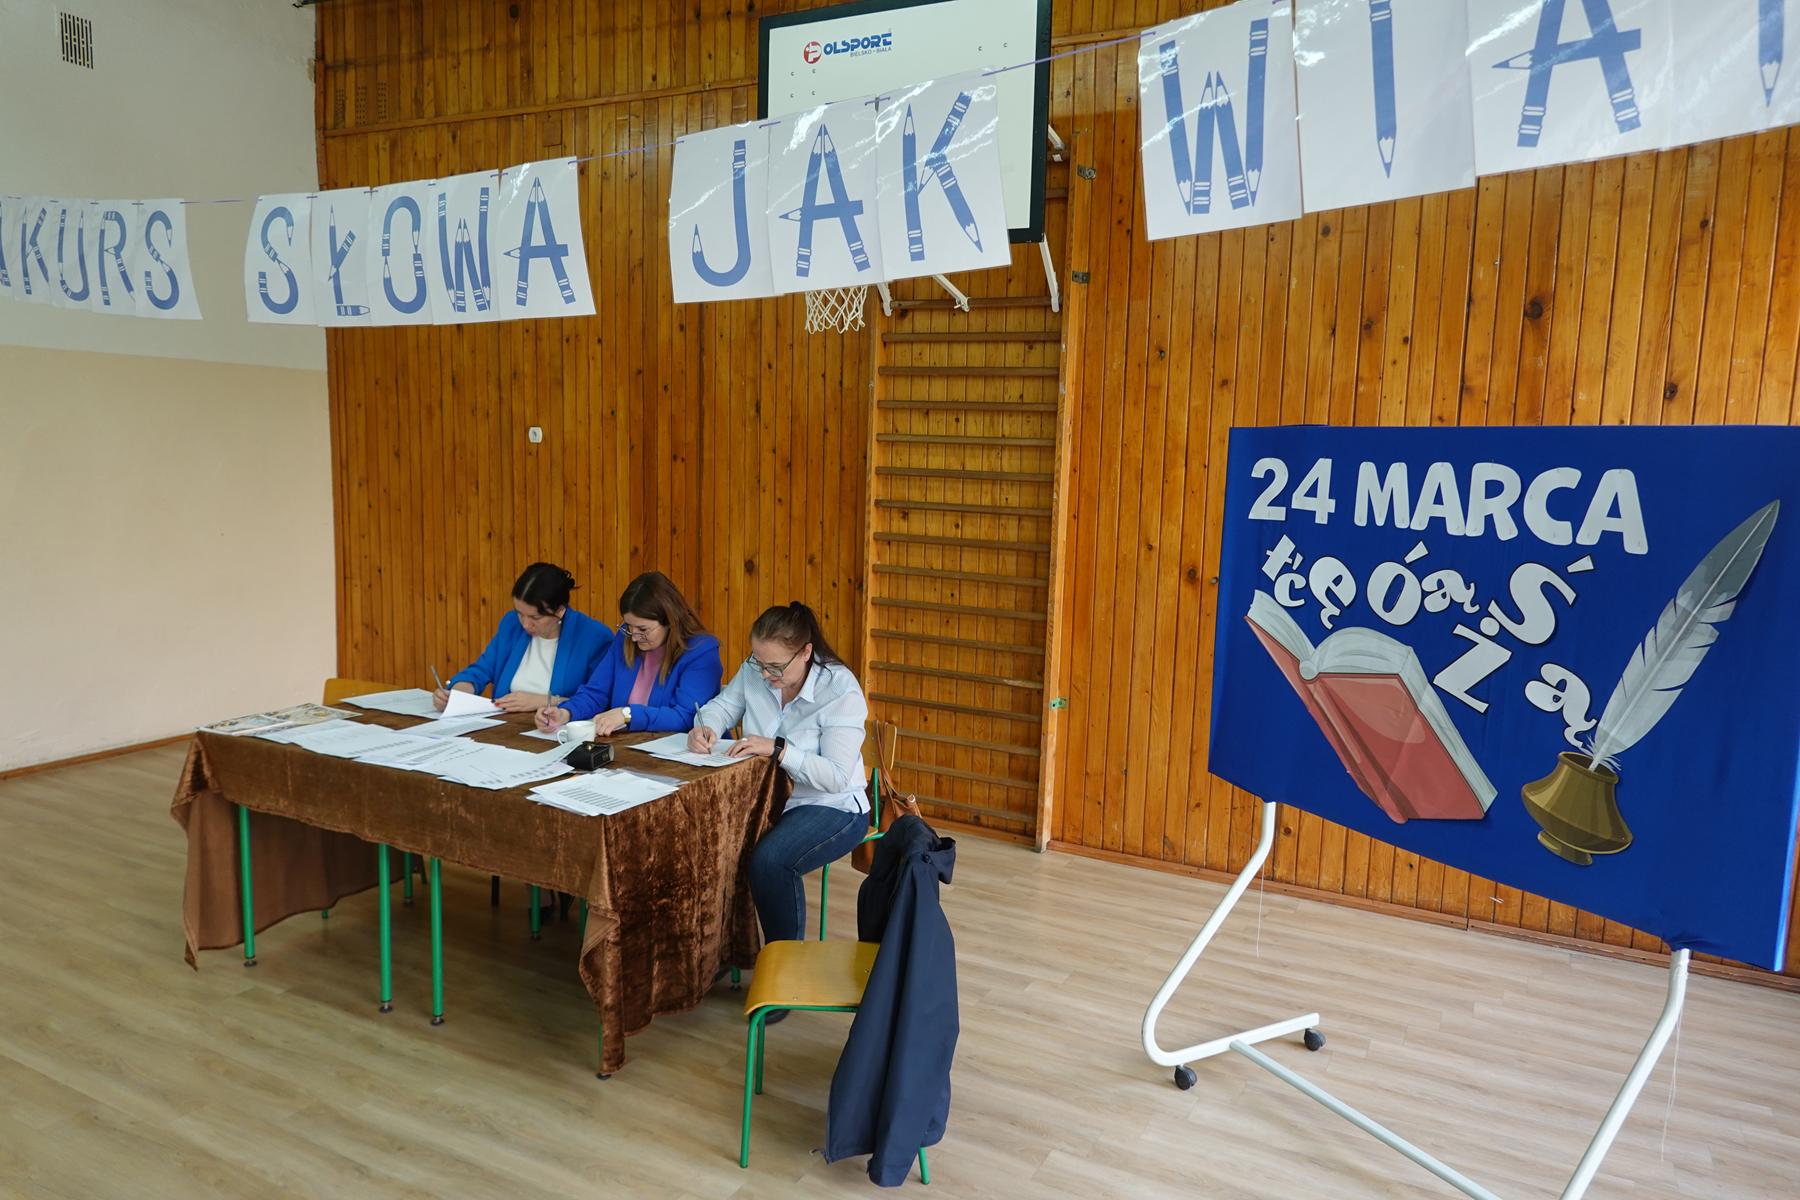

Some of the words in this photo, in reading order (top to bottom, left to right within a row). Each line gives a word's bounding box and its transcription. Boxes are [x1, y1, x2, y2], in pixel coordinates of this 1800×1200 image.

[0, 204, 180, 311] KURS
[258, 176, 576, 316] SŁOWA
[691, 91, 984, 288] JAK
[1248, 457, 1336, 524] 24
[1354, 461, 1650, 555] MARCA
